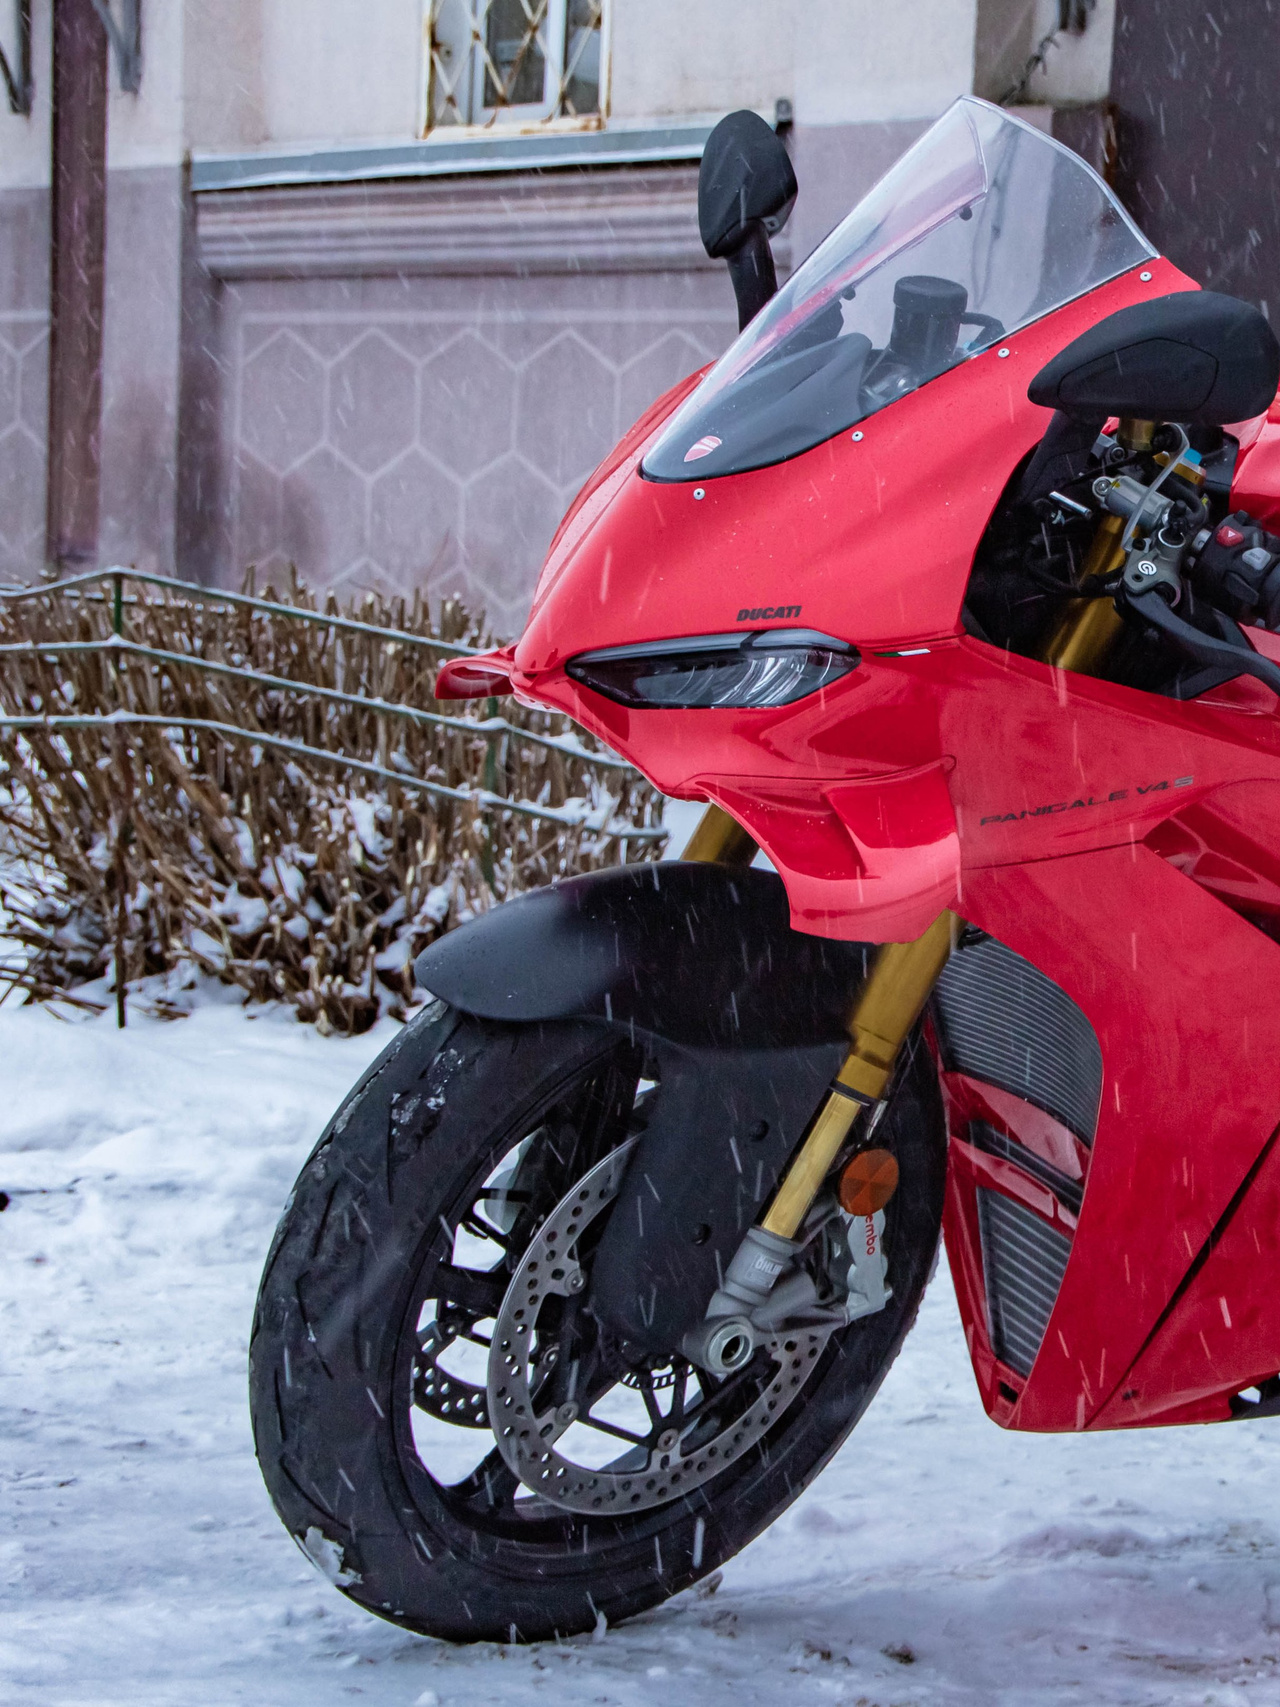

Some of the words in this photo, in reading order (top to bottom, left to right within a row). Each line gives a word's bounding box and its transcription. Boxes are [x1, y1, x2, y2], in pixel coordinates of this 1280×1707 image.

[736, 605, 802, 622] DUCATI
[980, 788, 1128, 826] PANIGALE
[865, 1213, 877, 1256] embo
